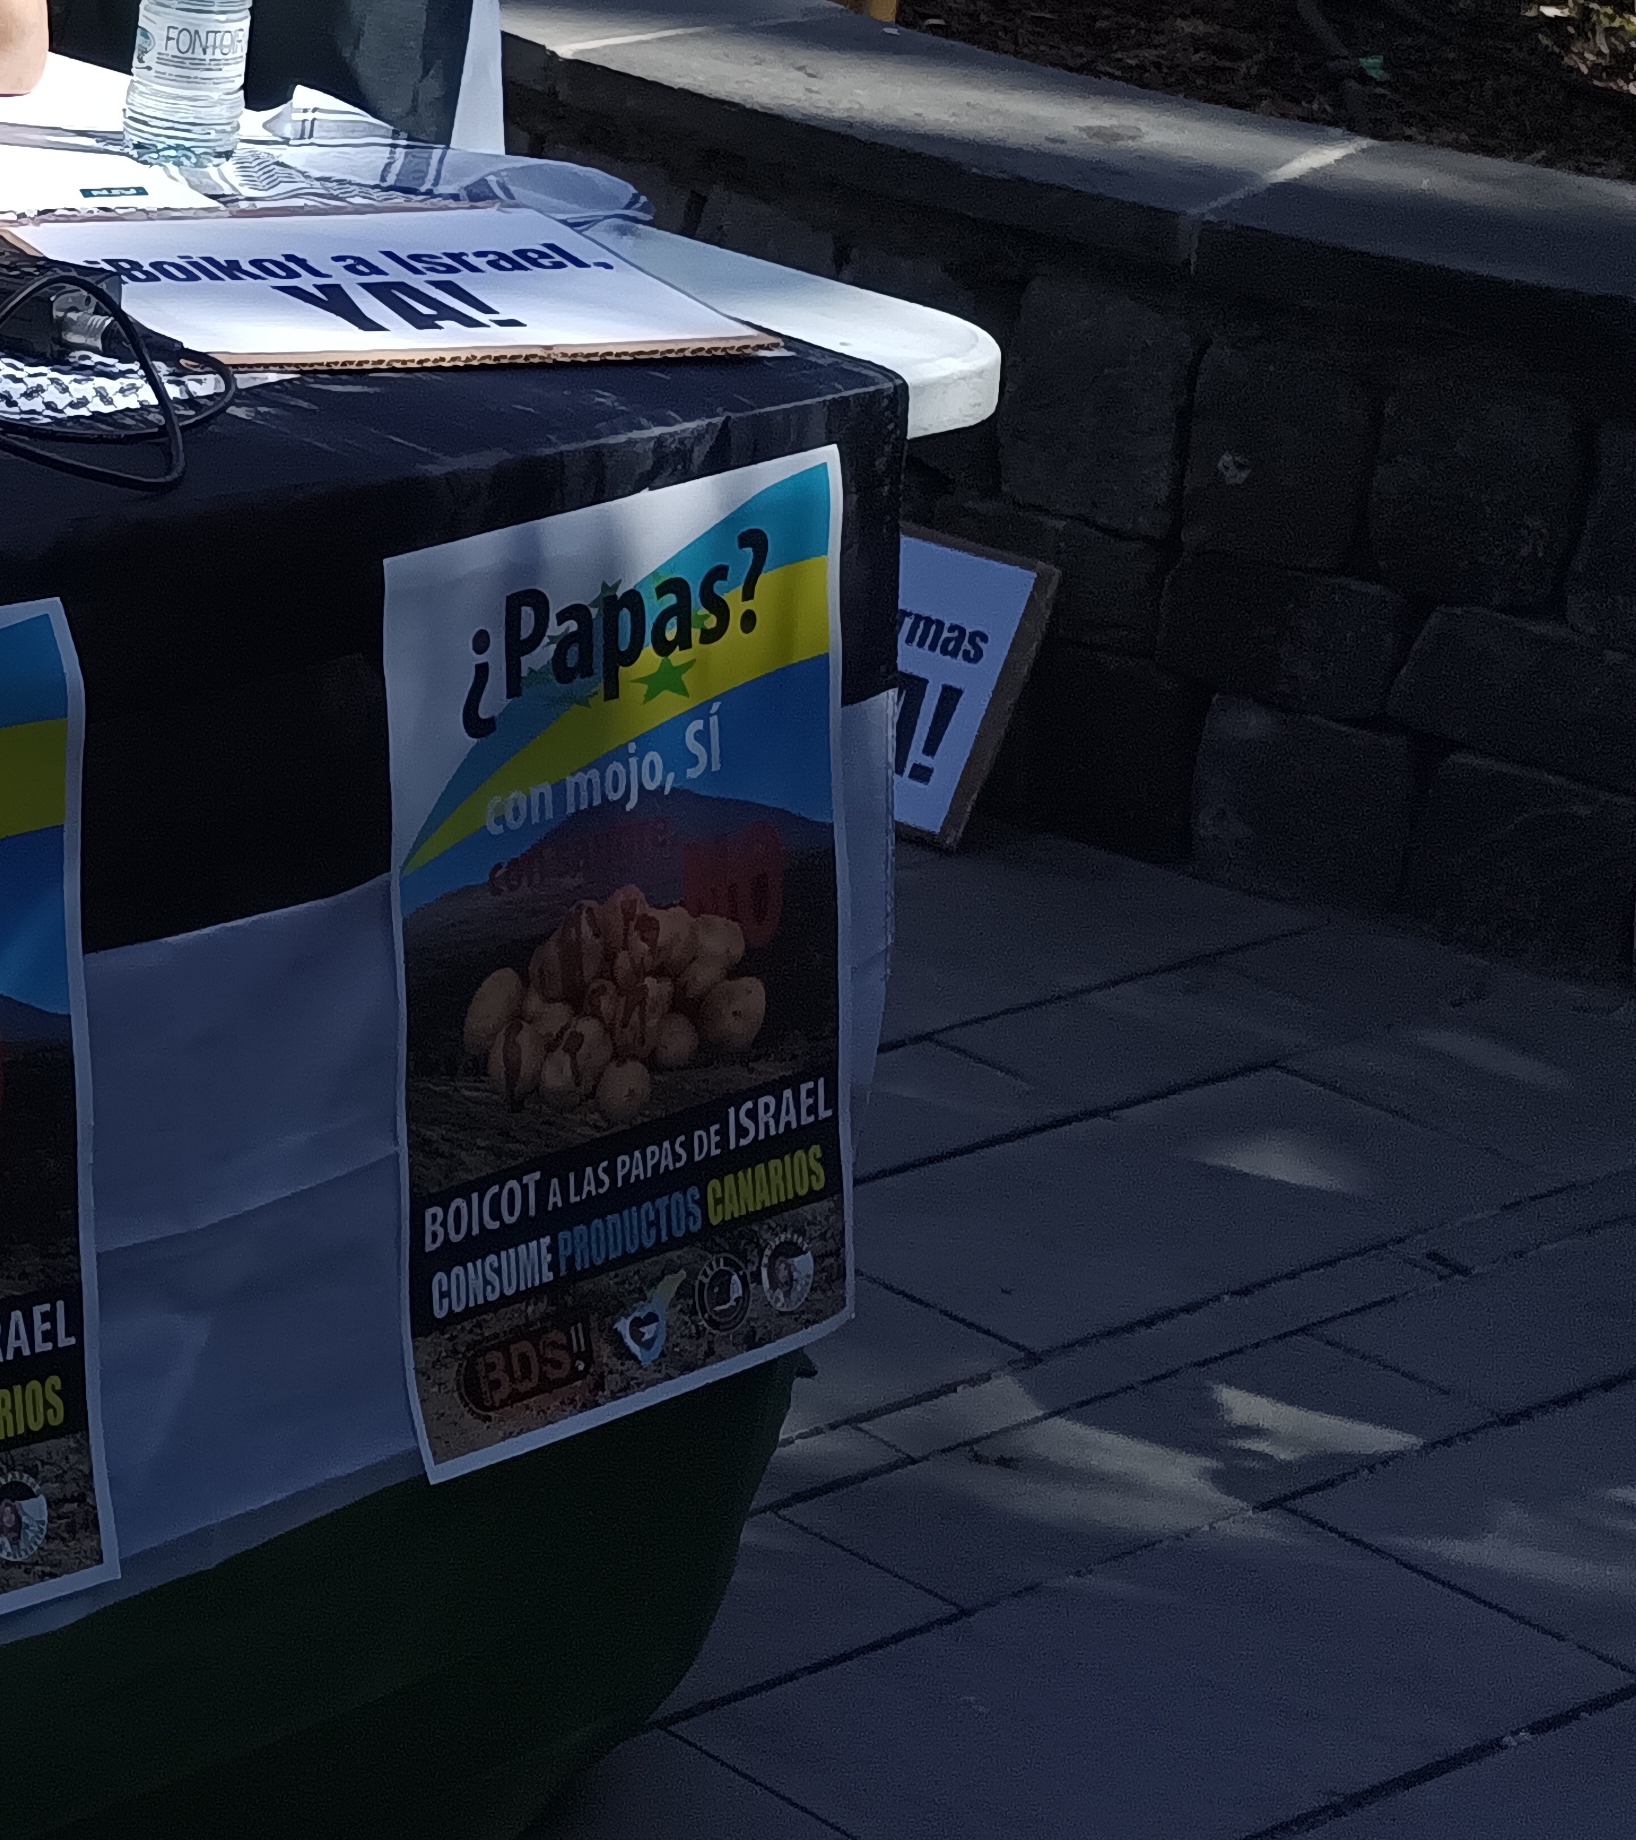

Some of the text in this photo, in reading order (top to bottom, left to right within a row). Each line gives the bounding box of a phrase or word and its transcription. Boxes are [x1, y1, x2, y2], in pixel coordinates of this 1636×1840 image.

[271, 279, 527, 332] YA!
[331, 254, 389, 276] a
[378, 242, 614, 276] Israel,
[462, 528, 769, 740] ¿Papas?
[485, 701, 722, 834] con mojo, SÍ
[424, 1076, 833, 1253] BOICOT A LAS PAPAS DE ISRAEL
[431, 1144, 827, 1320] CONSUME PRODUCTOS CANARIOS
